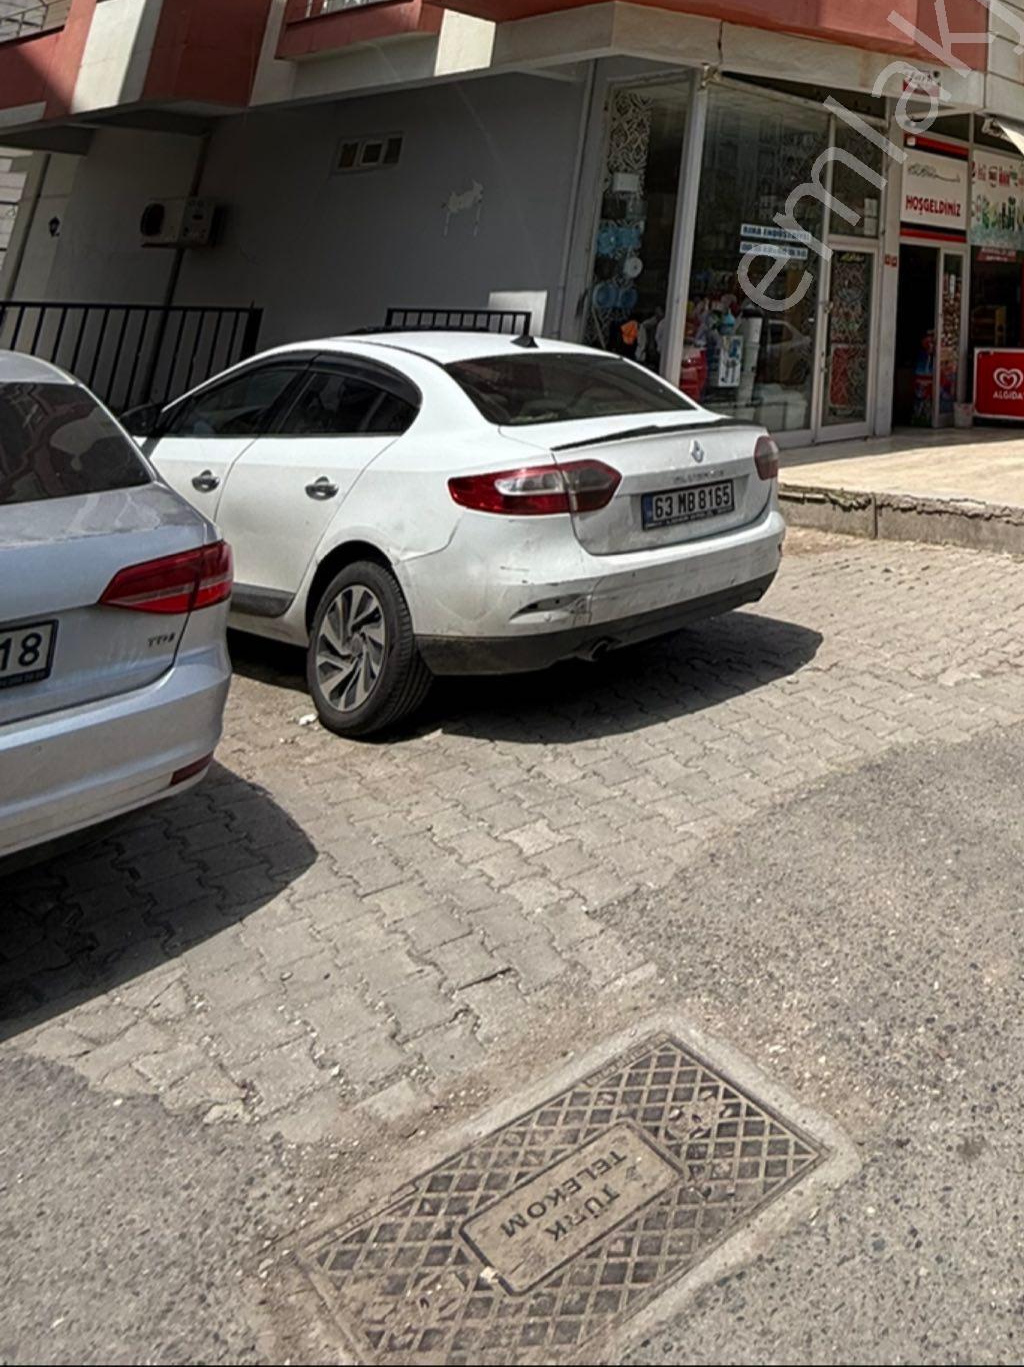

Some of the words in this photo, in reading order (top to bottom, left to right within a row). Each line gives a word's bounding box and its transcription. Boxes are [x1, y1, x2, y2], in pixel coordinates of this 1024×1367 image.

[905, 194, 961, 217] HOŞGELDİNİZ
[993, 390, 1024, 401] ALGIDA
[655, 495, 674, 519] 63
[677, 491, 696, 515] MB
[698, 485, 731, 510] 8165
[500, 1150, 627, 1237] TELEKOM
[545, 1185, 621, 1241] TÜRK
